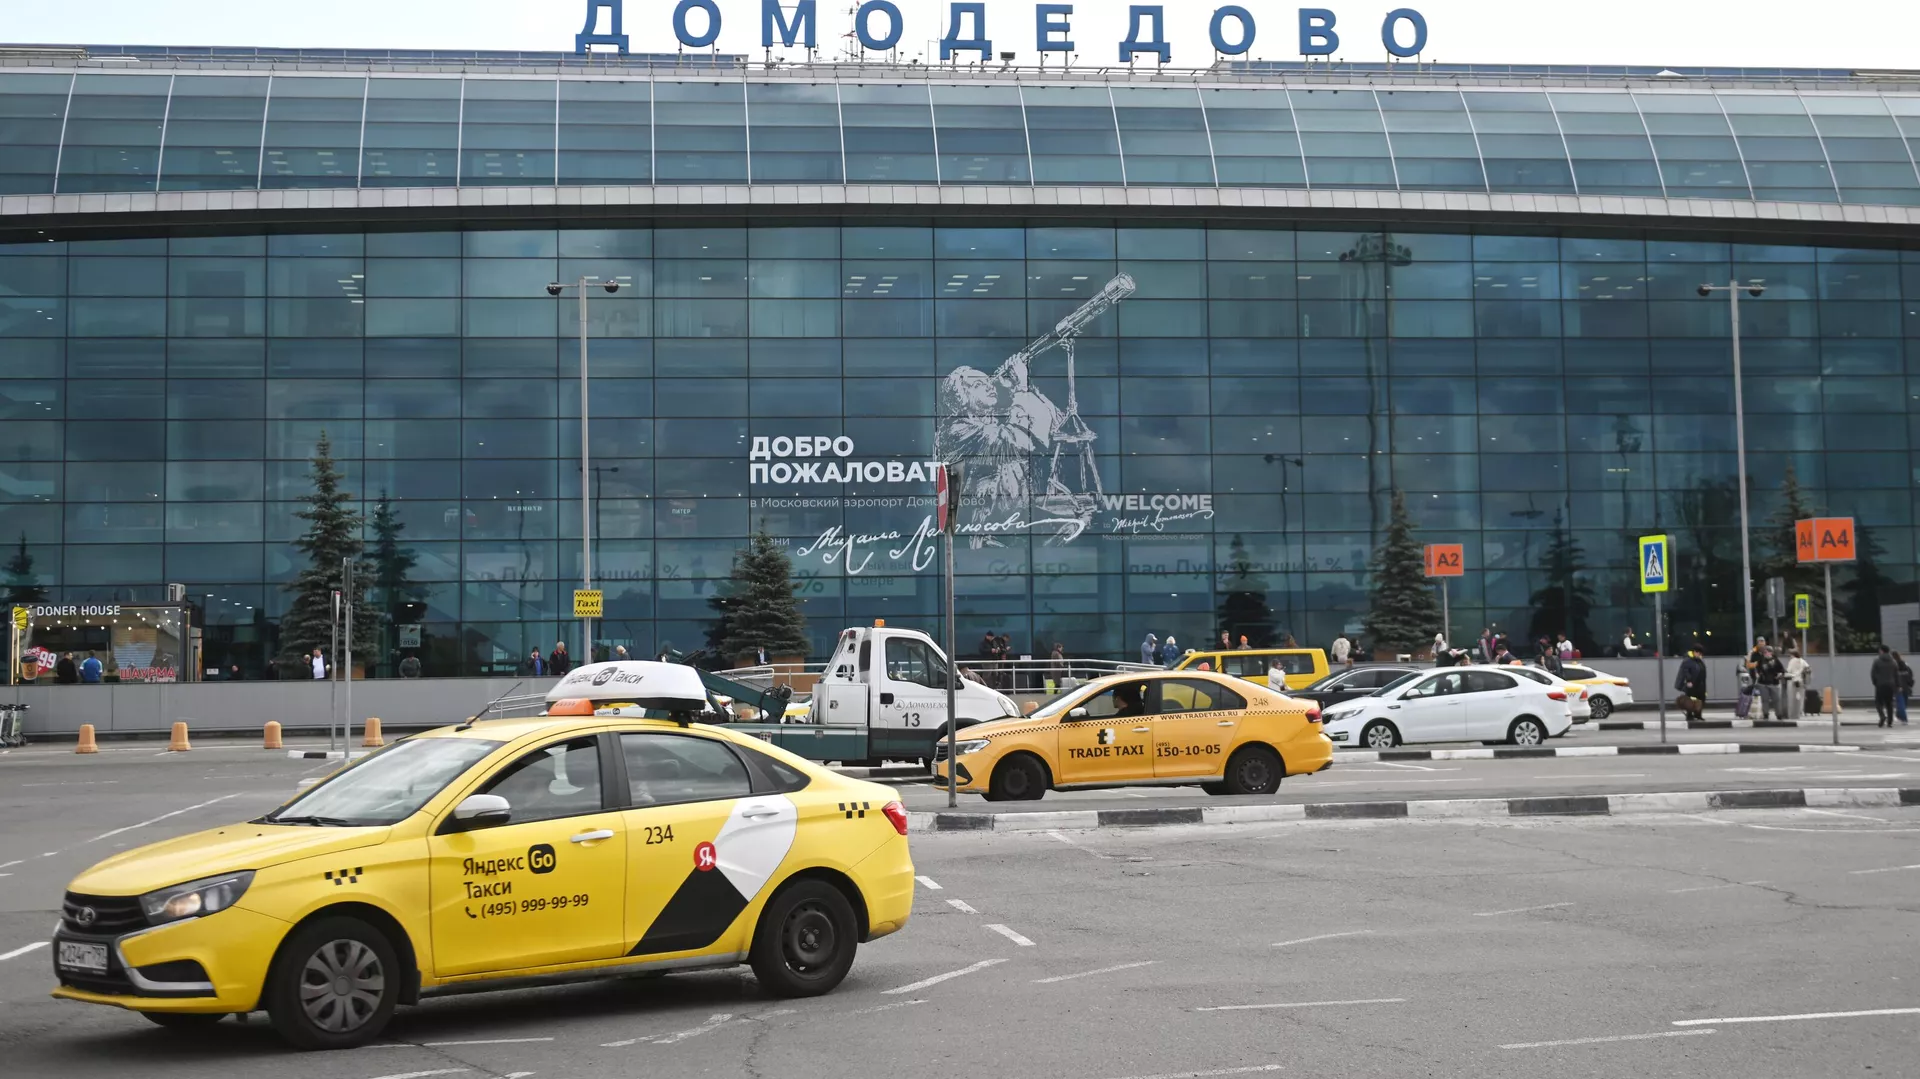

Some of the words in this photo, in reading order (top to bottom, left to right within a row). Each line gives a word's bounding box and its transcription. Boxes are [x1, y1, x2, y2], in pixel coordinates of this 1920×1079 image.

[575, 0, 1428, 57] ДОМОДЕДОВО
[750, 436, 854, 460] ДОБРО
[750, 461, 949, 484] ПОЖАЛОВАТ
[762, 497, 839, 508] Московский
[844, 499, 903, 509] аэропорт
[906, 496, 986, 508] Домоово
[1102, 494, 1212, 511] WELCOME
[751, 538, 790, 546] ини
[1820, 529, 1849, 548] A4
[1437, 552, 1460, 567] A2
[36, 606, 77, 616] DONER
[81, 605, 121, 616] HOUSE
[576, 599, 600, 607] Taxi
[120, 666, 177, 680] ШАУРМА
[612, 670, 645, 684] Такси
[1253, 697, 1269, 707] 248
[902, 712, 921, 727] 13
[1160, 711, 1239, 721] WWW.TRADETAXI.RU
[1068, 746, 1111, 758] TRADE
[1114, 745, 1144, 757] TAXI
[1156, 744, 1221, 758] 150-10-05
[644, 824, 675, 845] 234
[463, 855, 525, 877] Яндекс
[529, 848, 555, 871] Go
[463, 880, 513, 900] Такси
[481, 900, 517, 919] (495)
[521, 893, 590, 914] 999-99-99
